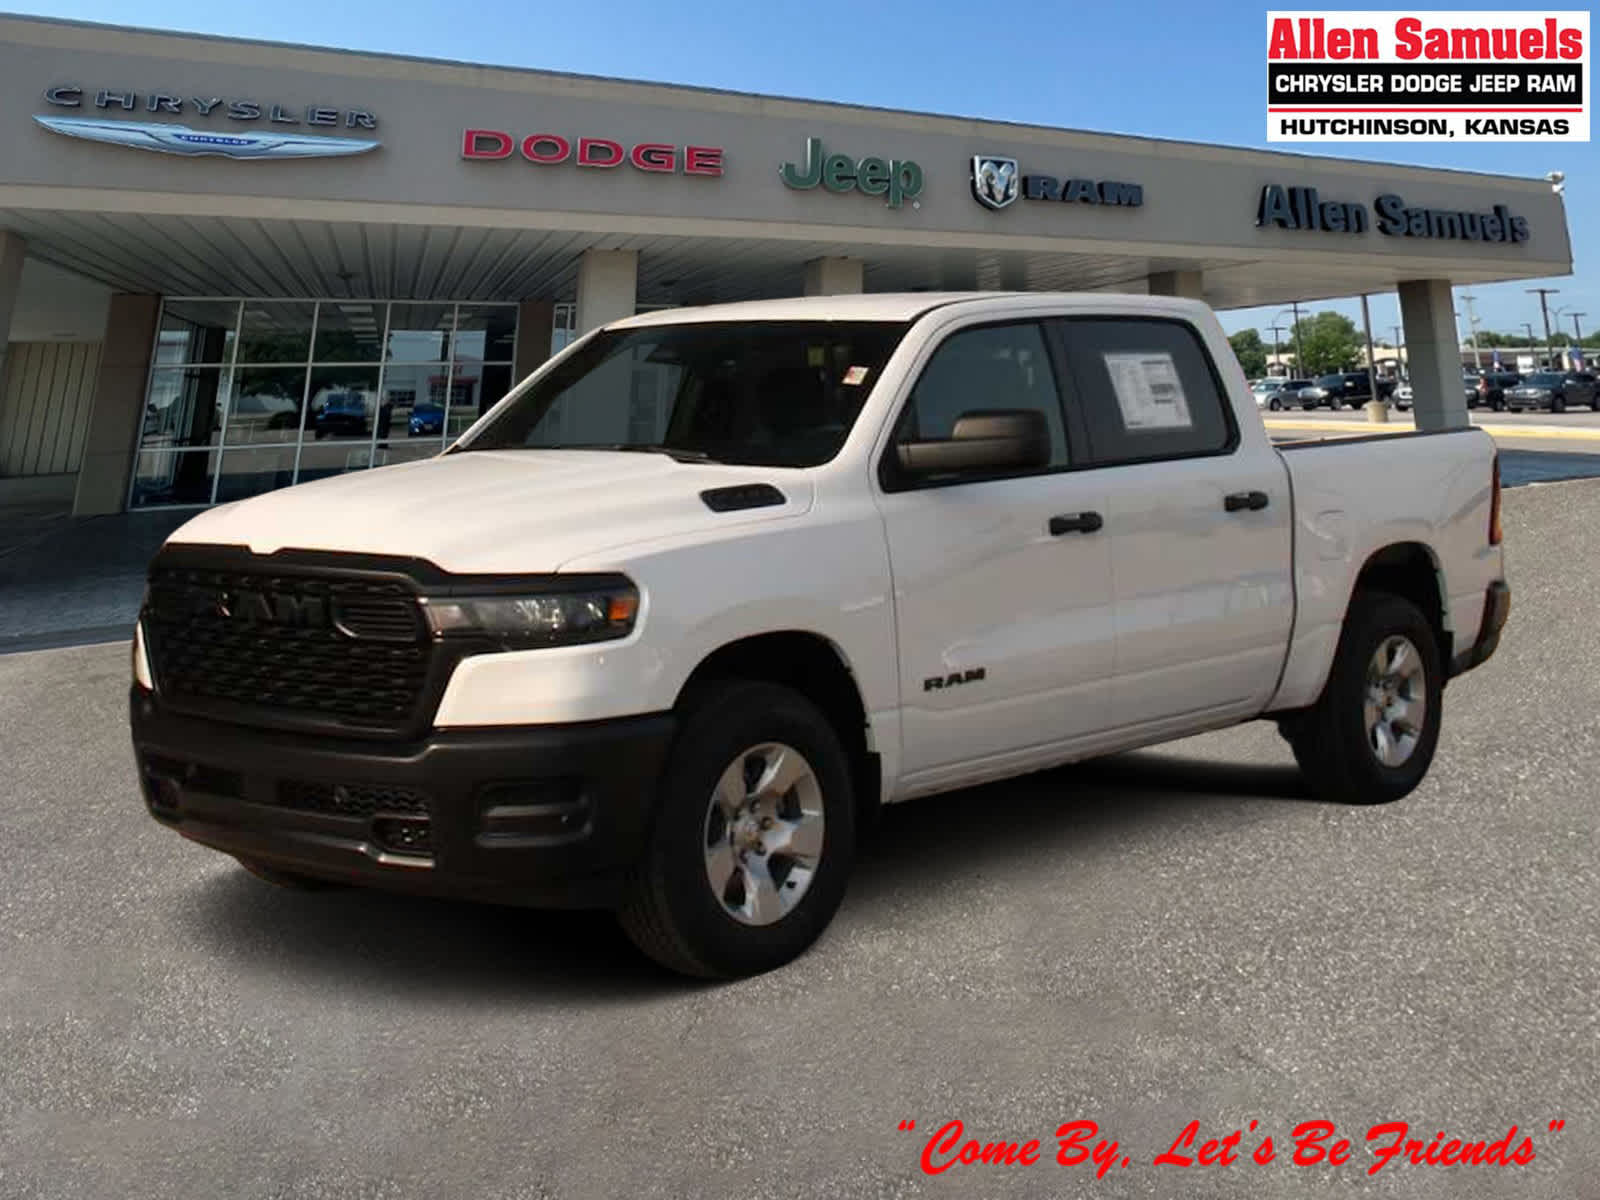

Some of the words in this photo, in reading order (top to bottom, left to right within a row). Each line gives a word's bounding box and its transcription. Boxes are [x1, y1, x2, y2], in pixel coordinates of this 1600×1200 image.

[44, 86, 378, 129] CHRYSLER
[462, 128, 725, 177] DODGE
[779, 137, 924, 209] Jeep
[1023, 175, 1144, 207] RAM
[1256, 184, 1369, 233] Allen
[1375, 194, 1530, 243] Samuels
[923, 667, 986, 692] RAM
